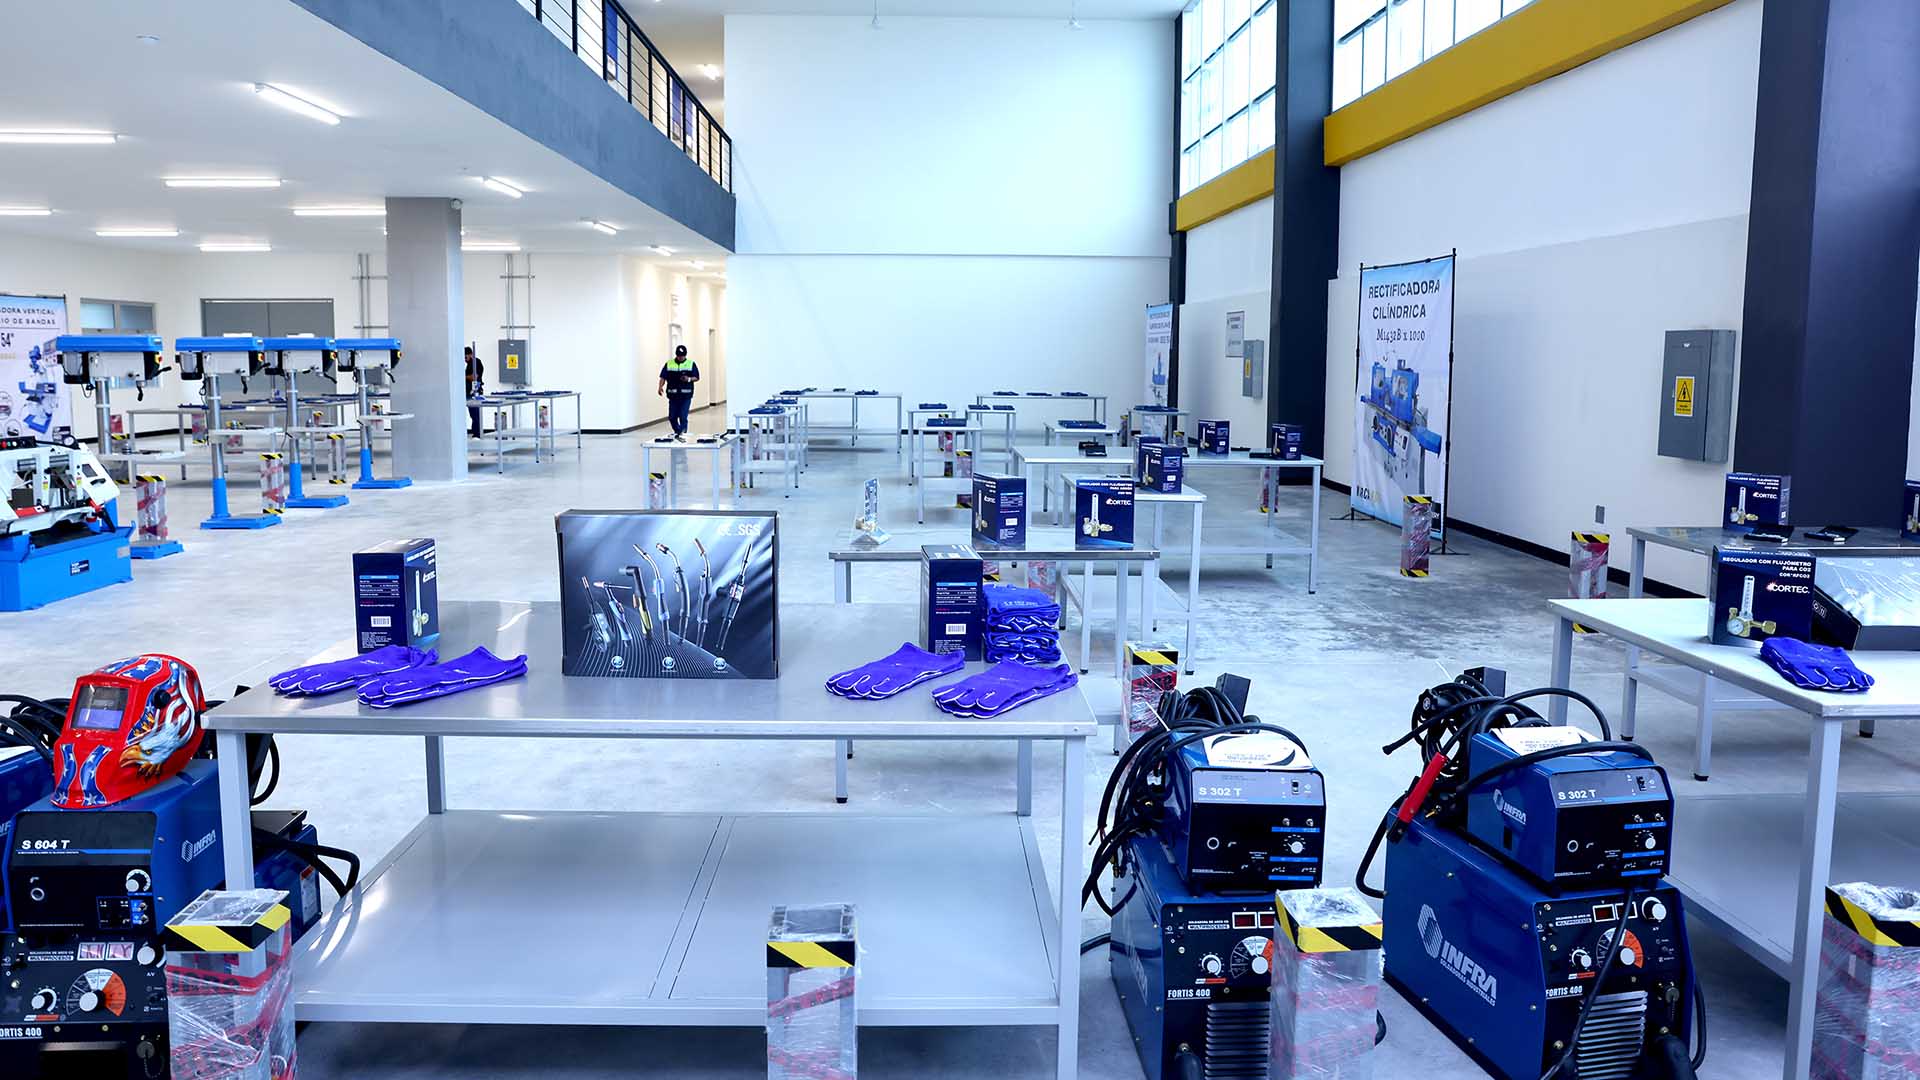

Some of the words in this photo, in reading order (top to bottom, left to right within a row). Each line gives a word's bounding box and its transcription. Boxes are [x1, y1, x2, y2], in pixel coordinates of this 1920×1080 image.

[1368, 279, 1440, 299] RECTIFICADORA
[1372, 302, 1426, 320] CILÍNDRICA
[1199, 787, 1207, 796] S
[1210, 787, 1232, 796] 302
[1233, 788, 1242, 798] T
[1558, 791, 1566, 800] S
[1568, 790, 1587, 800] 302
[1588, 789, 1596, 798] T
[1503, 802, 1526, 822] INFRA
[22, 840, 31, 849] S
[34, 840, 57, 849] 604
[61, 840, 70, 849] T
[193, 830, 216, 854] INFRA
[1441, 940, 1497, 1000] INFRA
[1168, 989, 1194, 998] FORTIS
[1195, 988, 1211, 997] 400
[1546, 987, 1568, 997] FORTIS
[1569, 985, 1582, 995] 400
[0, 1028, 23, 1037] ORTIS
[25, 1027, 42, 1037] 400
